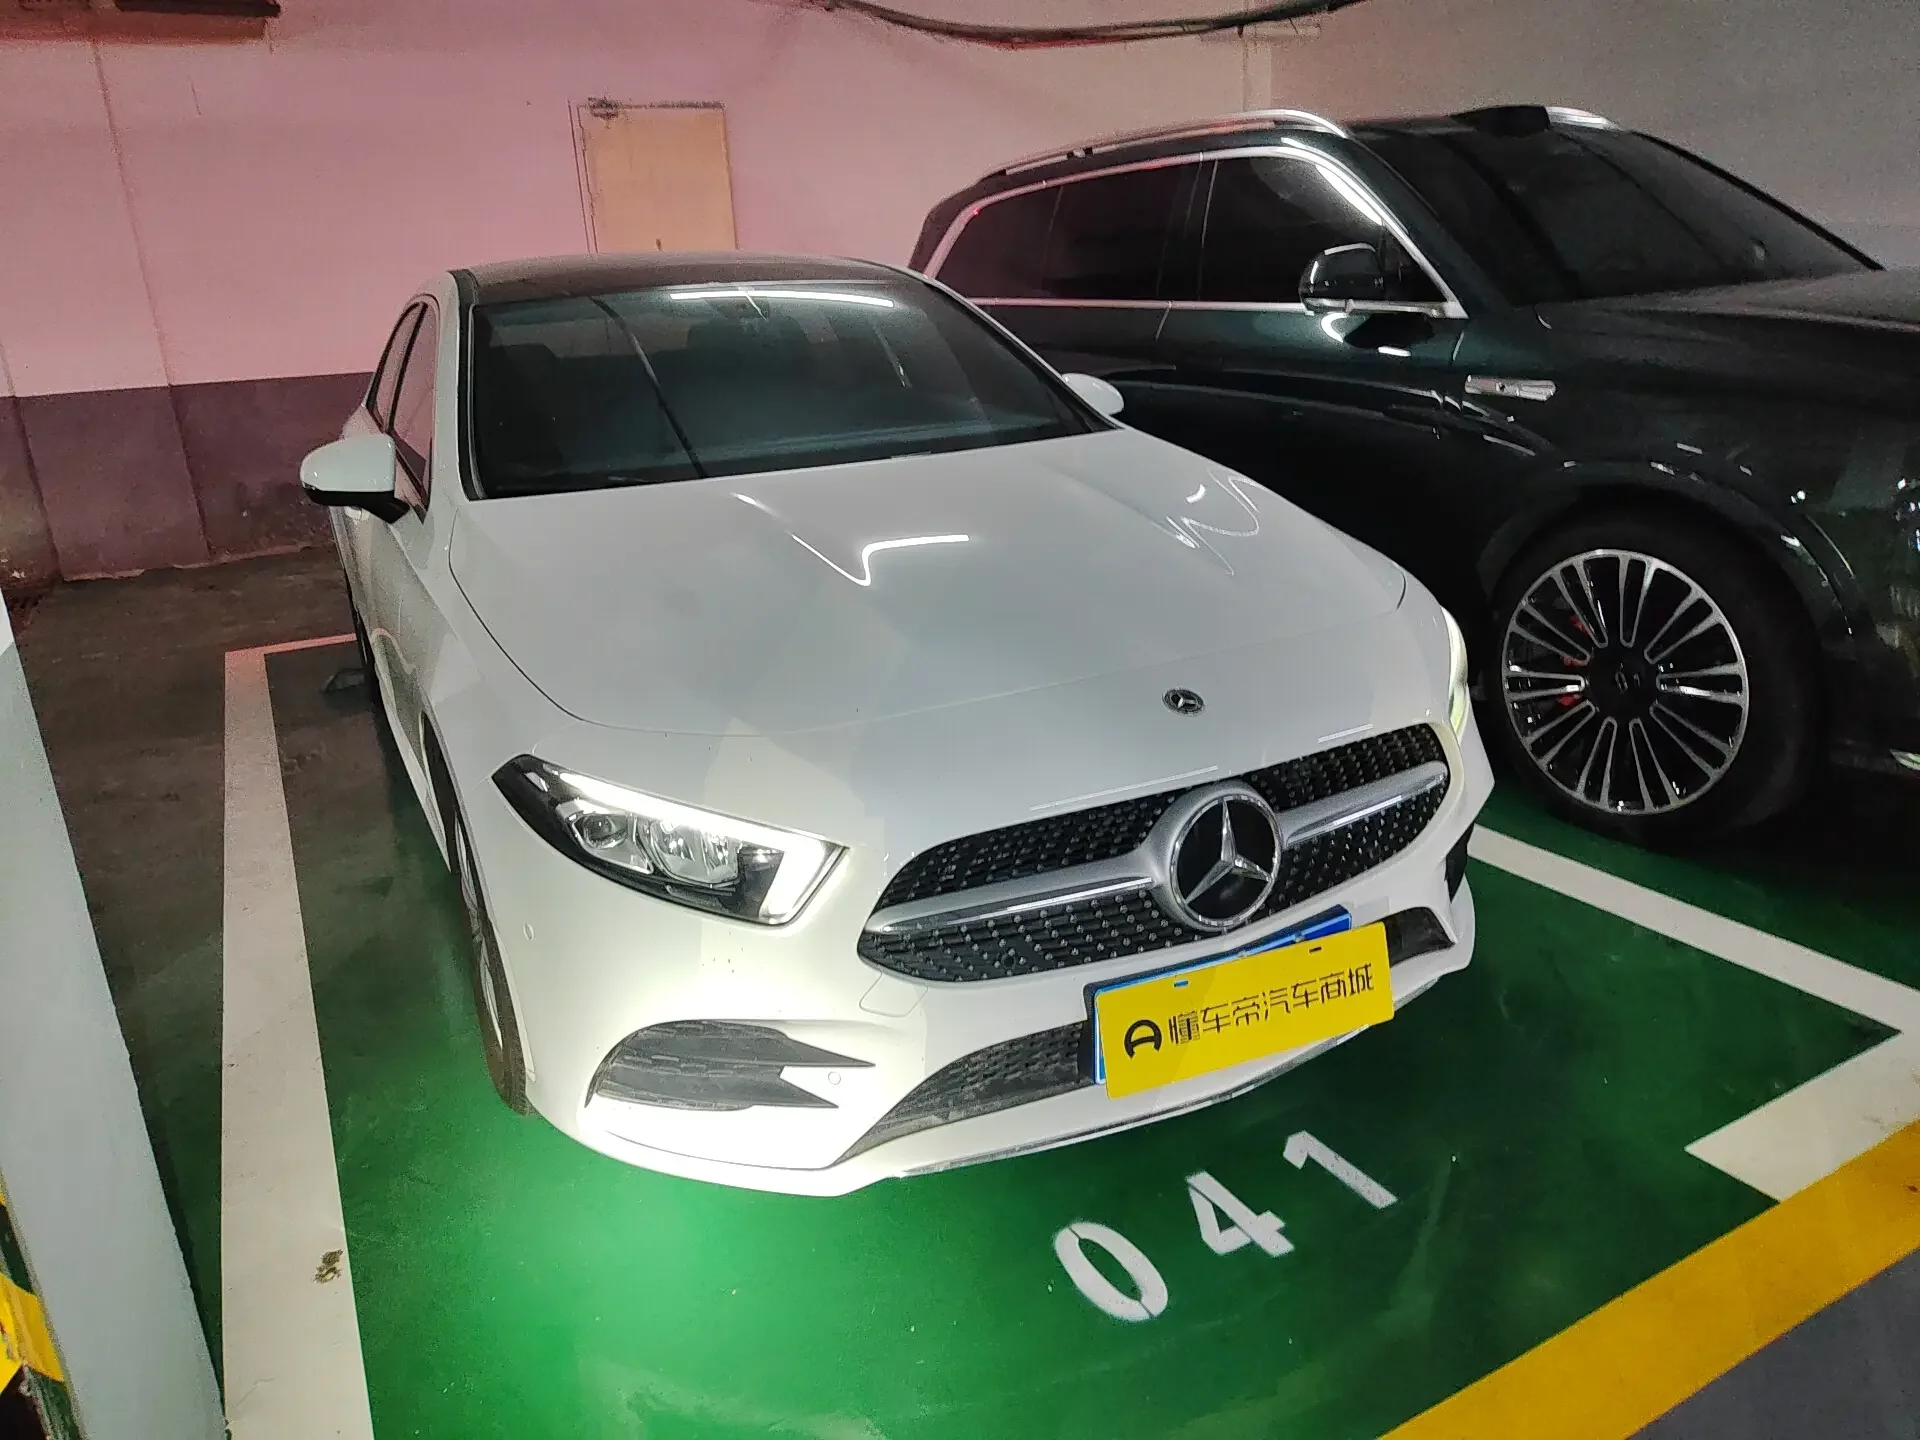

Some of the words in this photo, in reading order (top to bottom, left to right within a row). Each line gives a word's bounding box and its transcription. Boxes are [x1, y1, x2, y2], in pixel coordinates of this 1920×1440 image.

[1168, 962, 1375, 1045] 懂车帝汽车商城
[1054, 1130, 1398, 1322] 041
